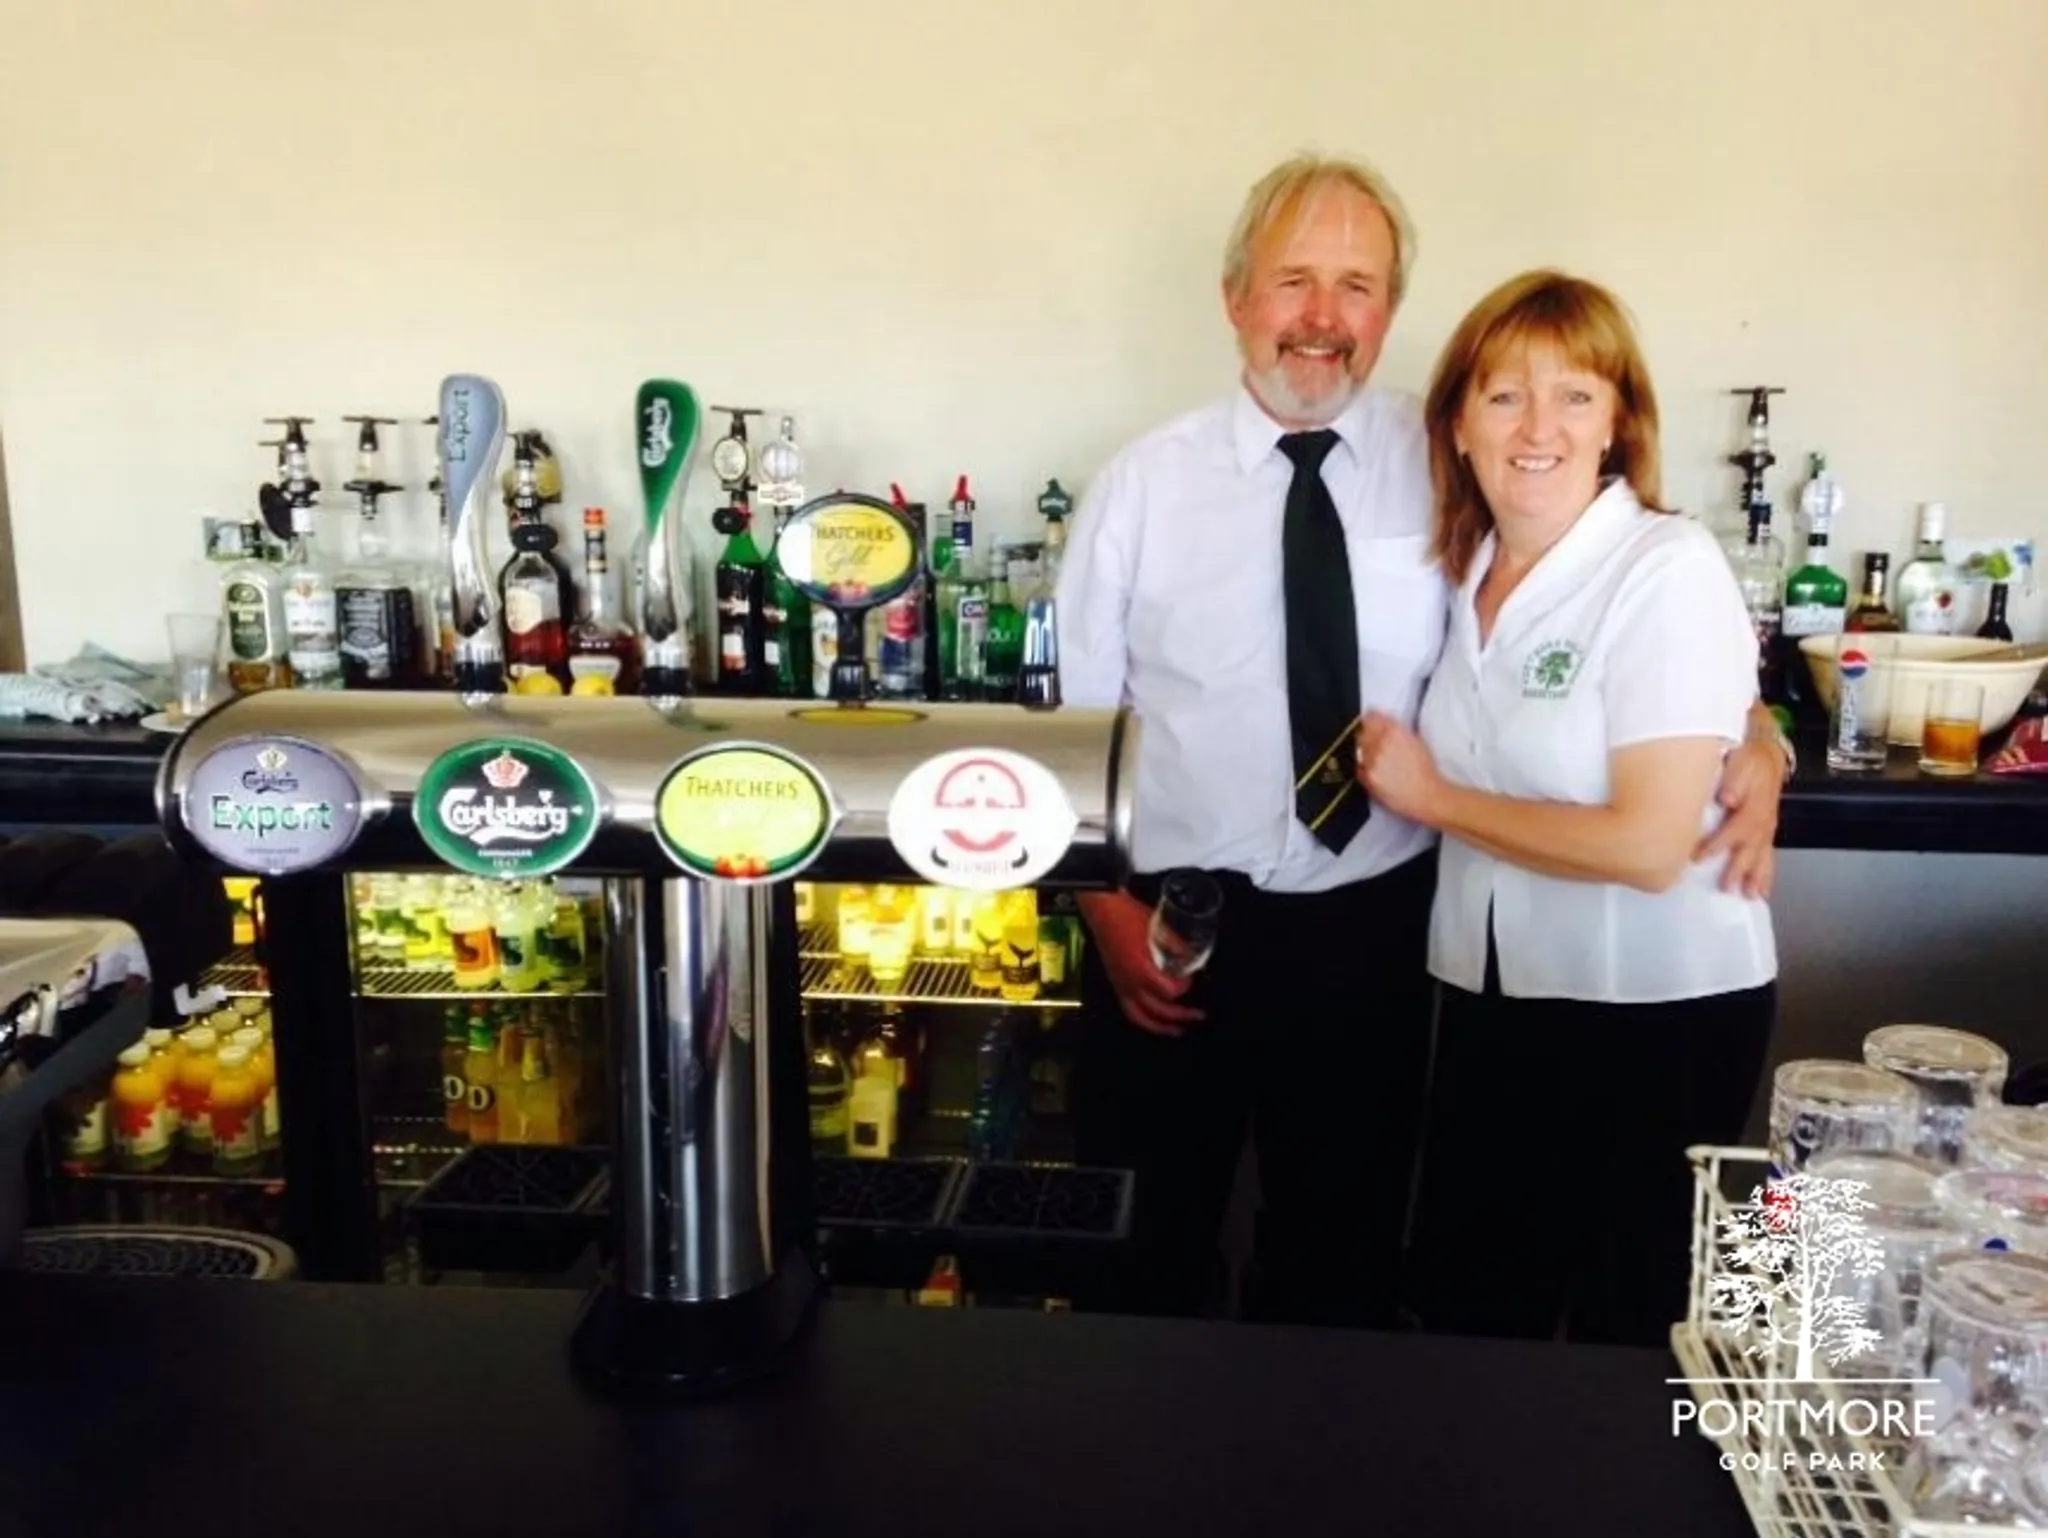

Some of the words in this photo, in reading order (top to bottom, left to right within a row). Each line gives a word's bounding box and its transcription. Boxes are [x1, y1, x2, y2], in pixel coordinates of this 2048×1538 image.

[447, 389, 471, 463] Export
[643, 397, 674, 467] Carlsberg
[211, 795, 331, 837] Export
[439, 787, 568, 846] Carlsberg
[684, 775, 800, 800] THATCHERS
